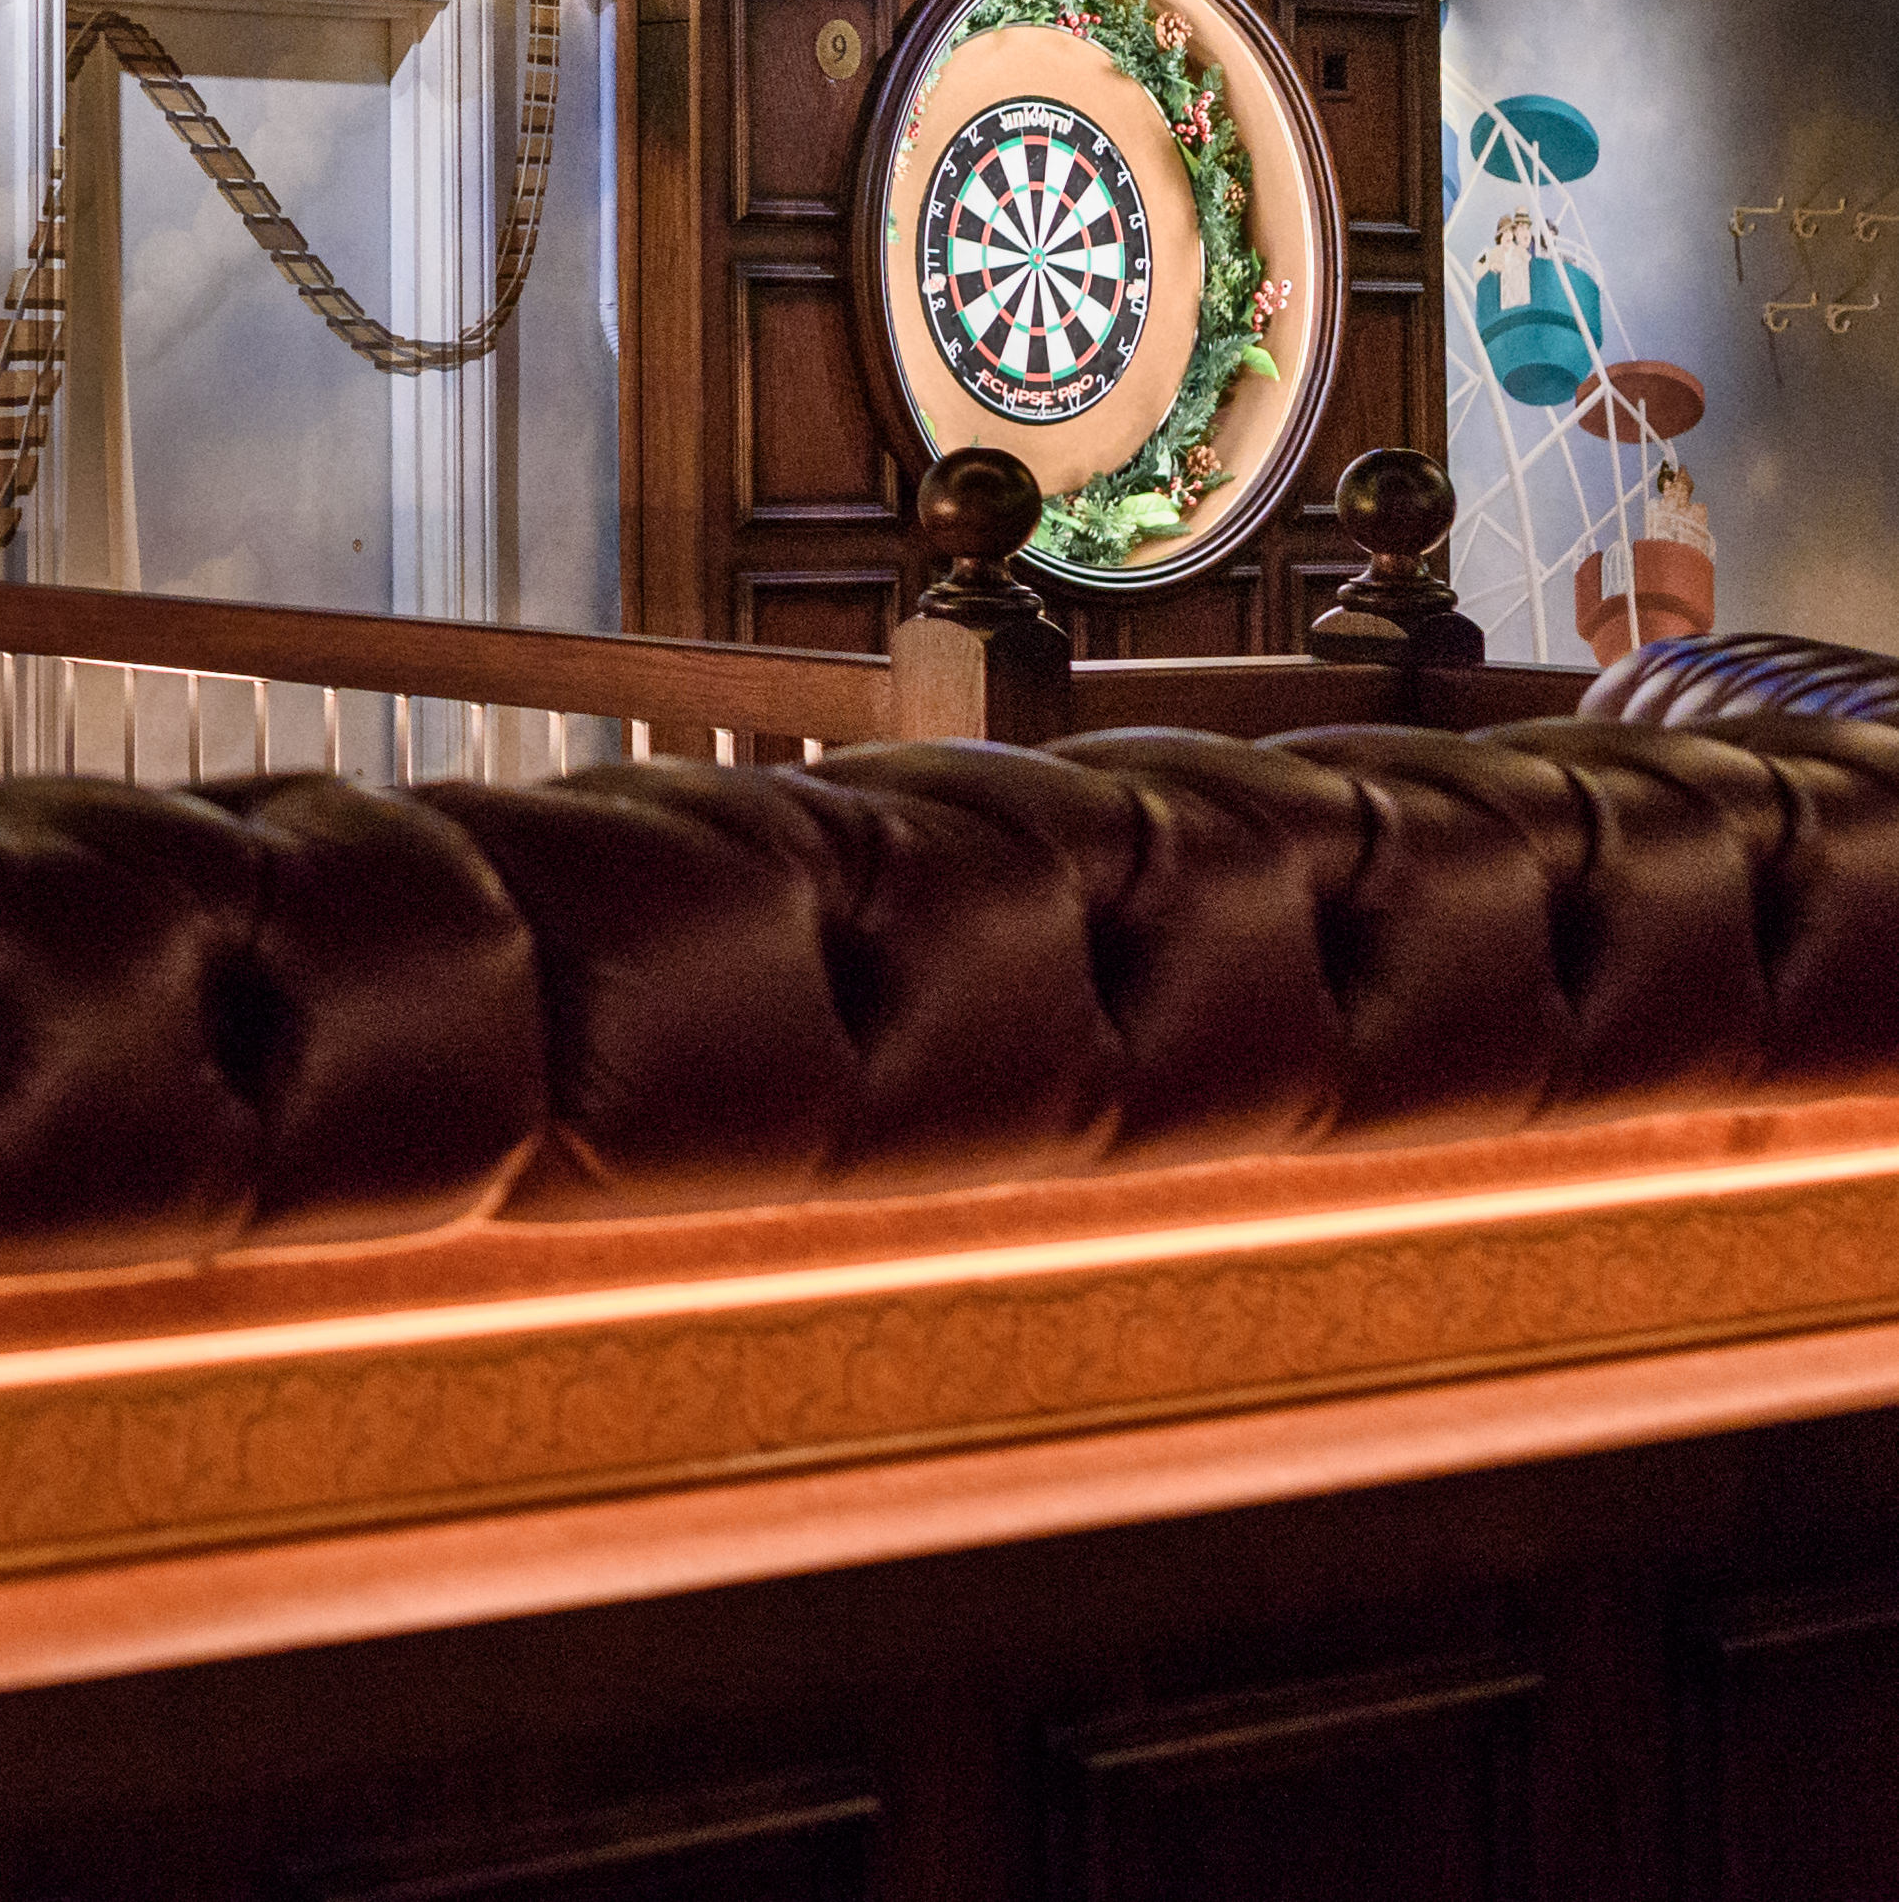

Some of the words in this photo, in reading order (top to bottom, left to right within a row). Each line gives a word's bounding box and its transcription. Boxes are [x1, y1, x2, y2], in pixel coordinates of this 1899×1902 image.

[832, 34, 847, 63] 9
[968, 126, 983, 147] 12
[944, 158, 958, 177] 9
[1117, 171, 1131, 187] 4
[931, 200, 946, 218] 14
[1128, 211, 1146, 229] 13
[931, 297, 946, 311] 8
[979, 368, 1054, 406] ECLIPSE
[1057, 373, 1095, 402] PRO
[1095, 374, 1112, 393] 2
